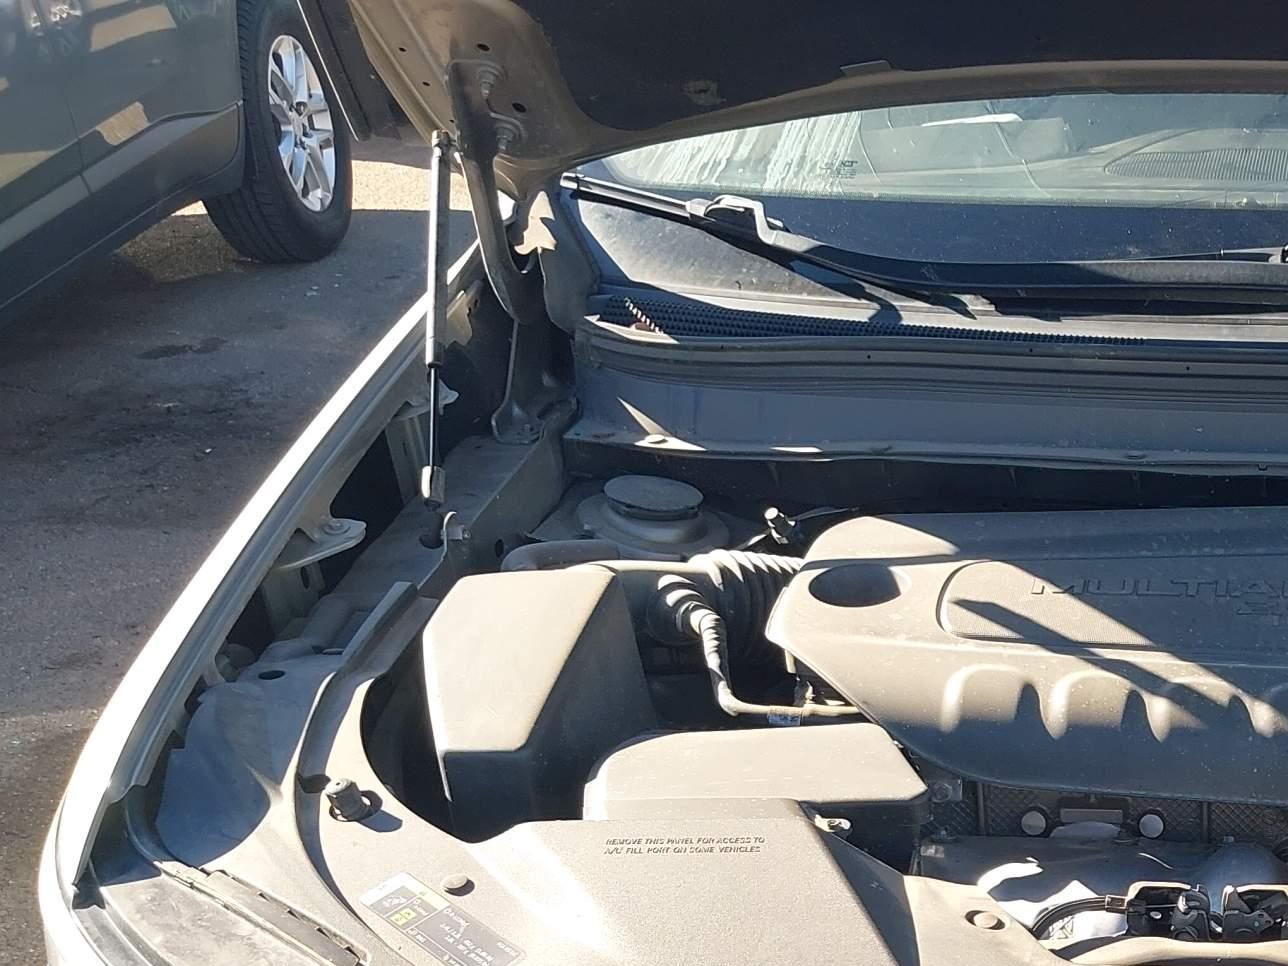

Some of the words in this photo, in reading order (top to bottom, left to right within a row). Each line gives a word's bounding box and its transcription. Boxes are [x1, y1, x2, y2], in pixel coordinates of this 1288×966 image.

[605, 838, 643, 846] REMOVE
[696, 837, 715, 845] FOR
[673, 846, 687, 854] ON
